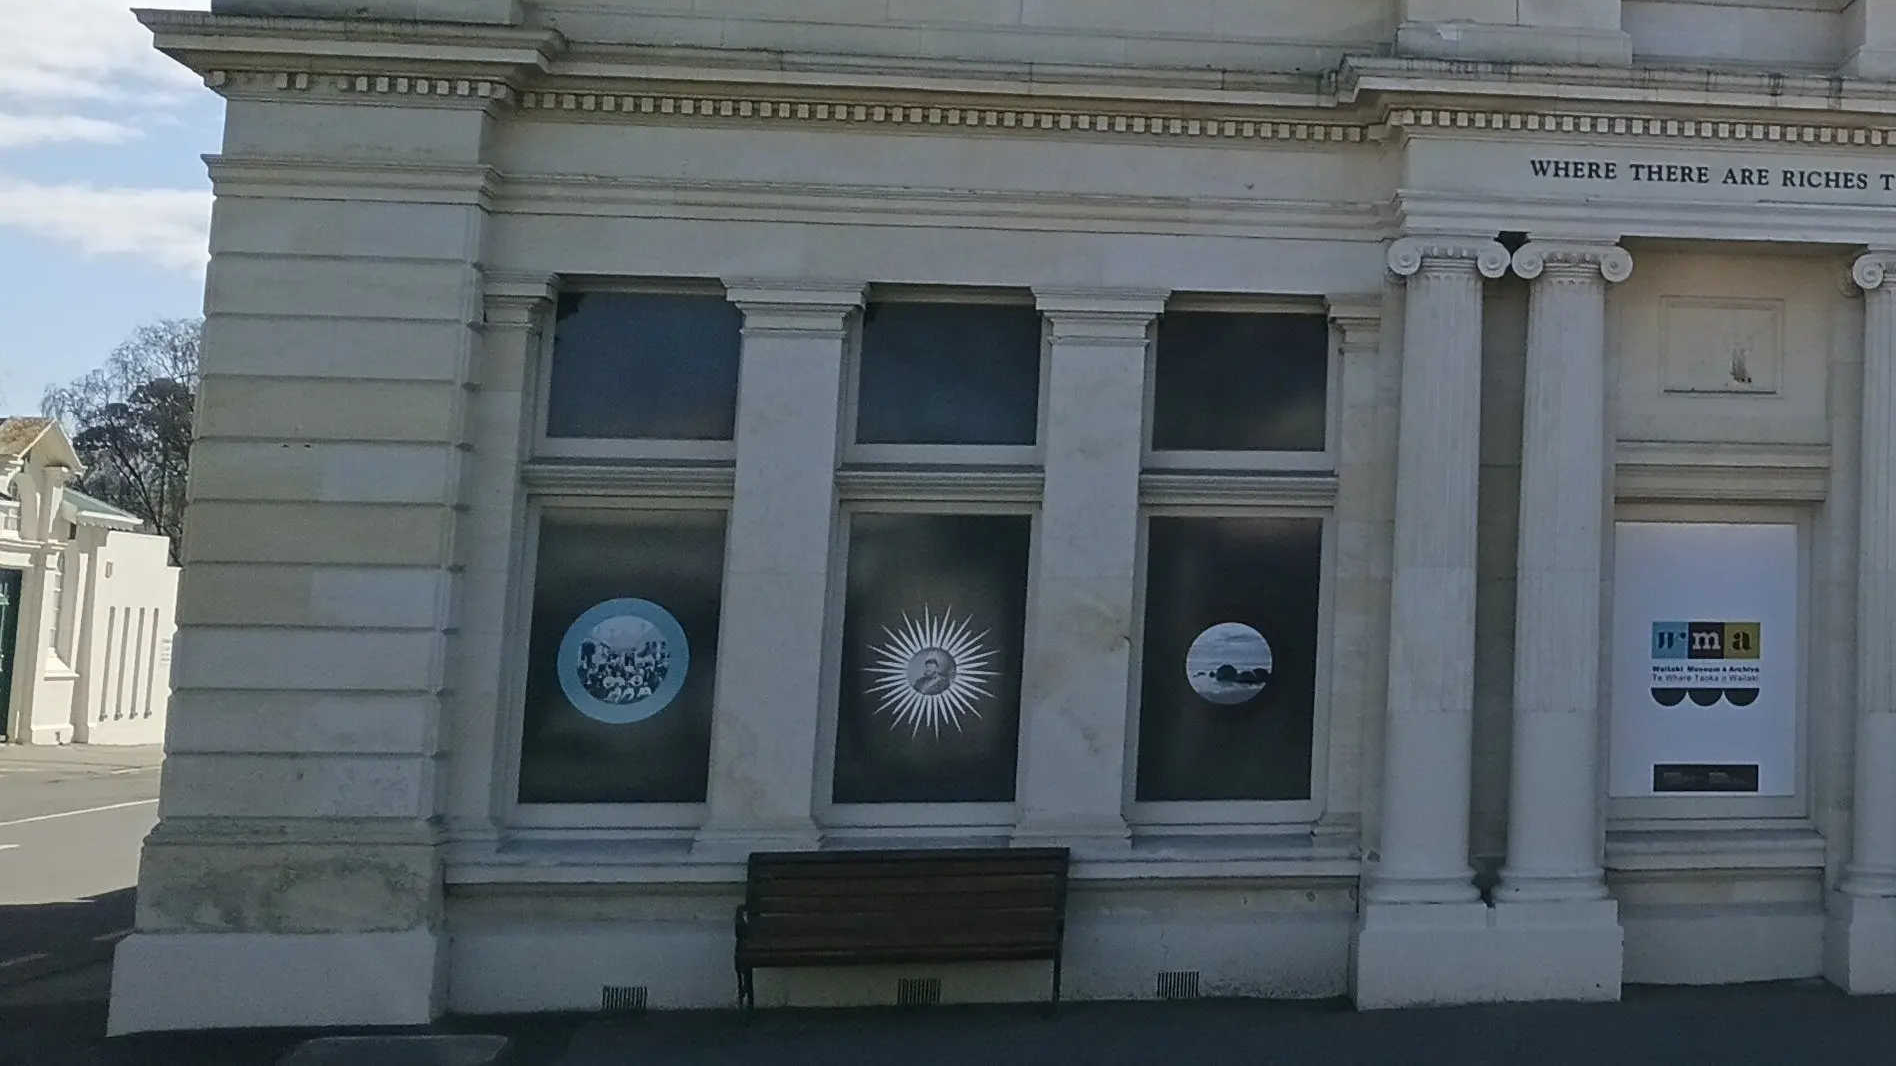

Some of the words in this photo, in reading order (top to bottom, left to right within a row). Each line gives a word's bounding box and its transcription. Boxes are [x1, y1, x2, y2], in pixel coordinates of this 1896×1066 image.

[1531, 160, 1616, 179] WHERE
[1630, 164, 1709, 183] THERE
[1723, 168, 1769, 185] ARE
[1782, 170, 1867, 189] RICHES
[1729, 665, 1760, 673] Archive
